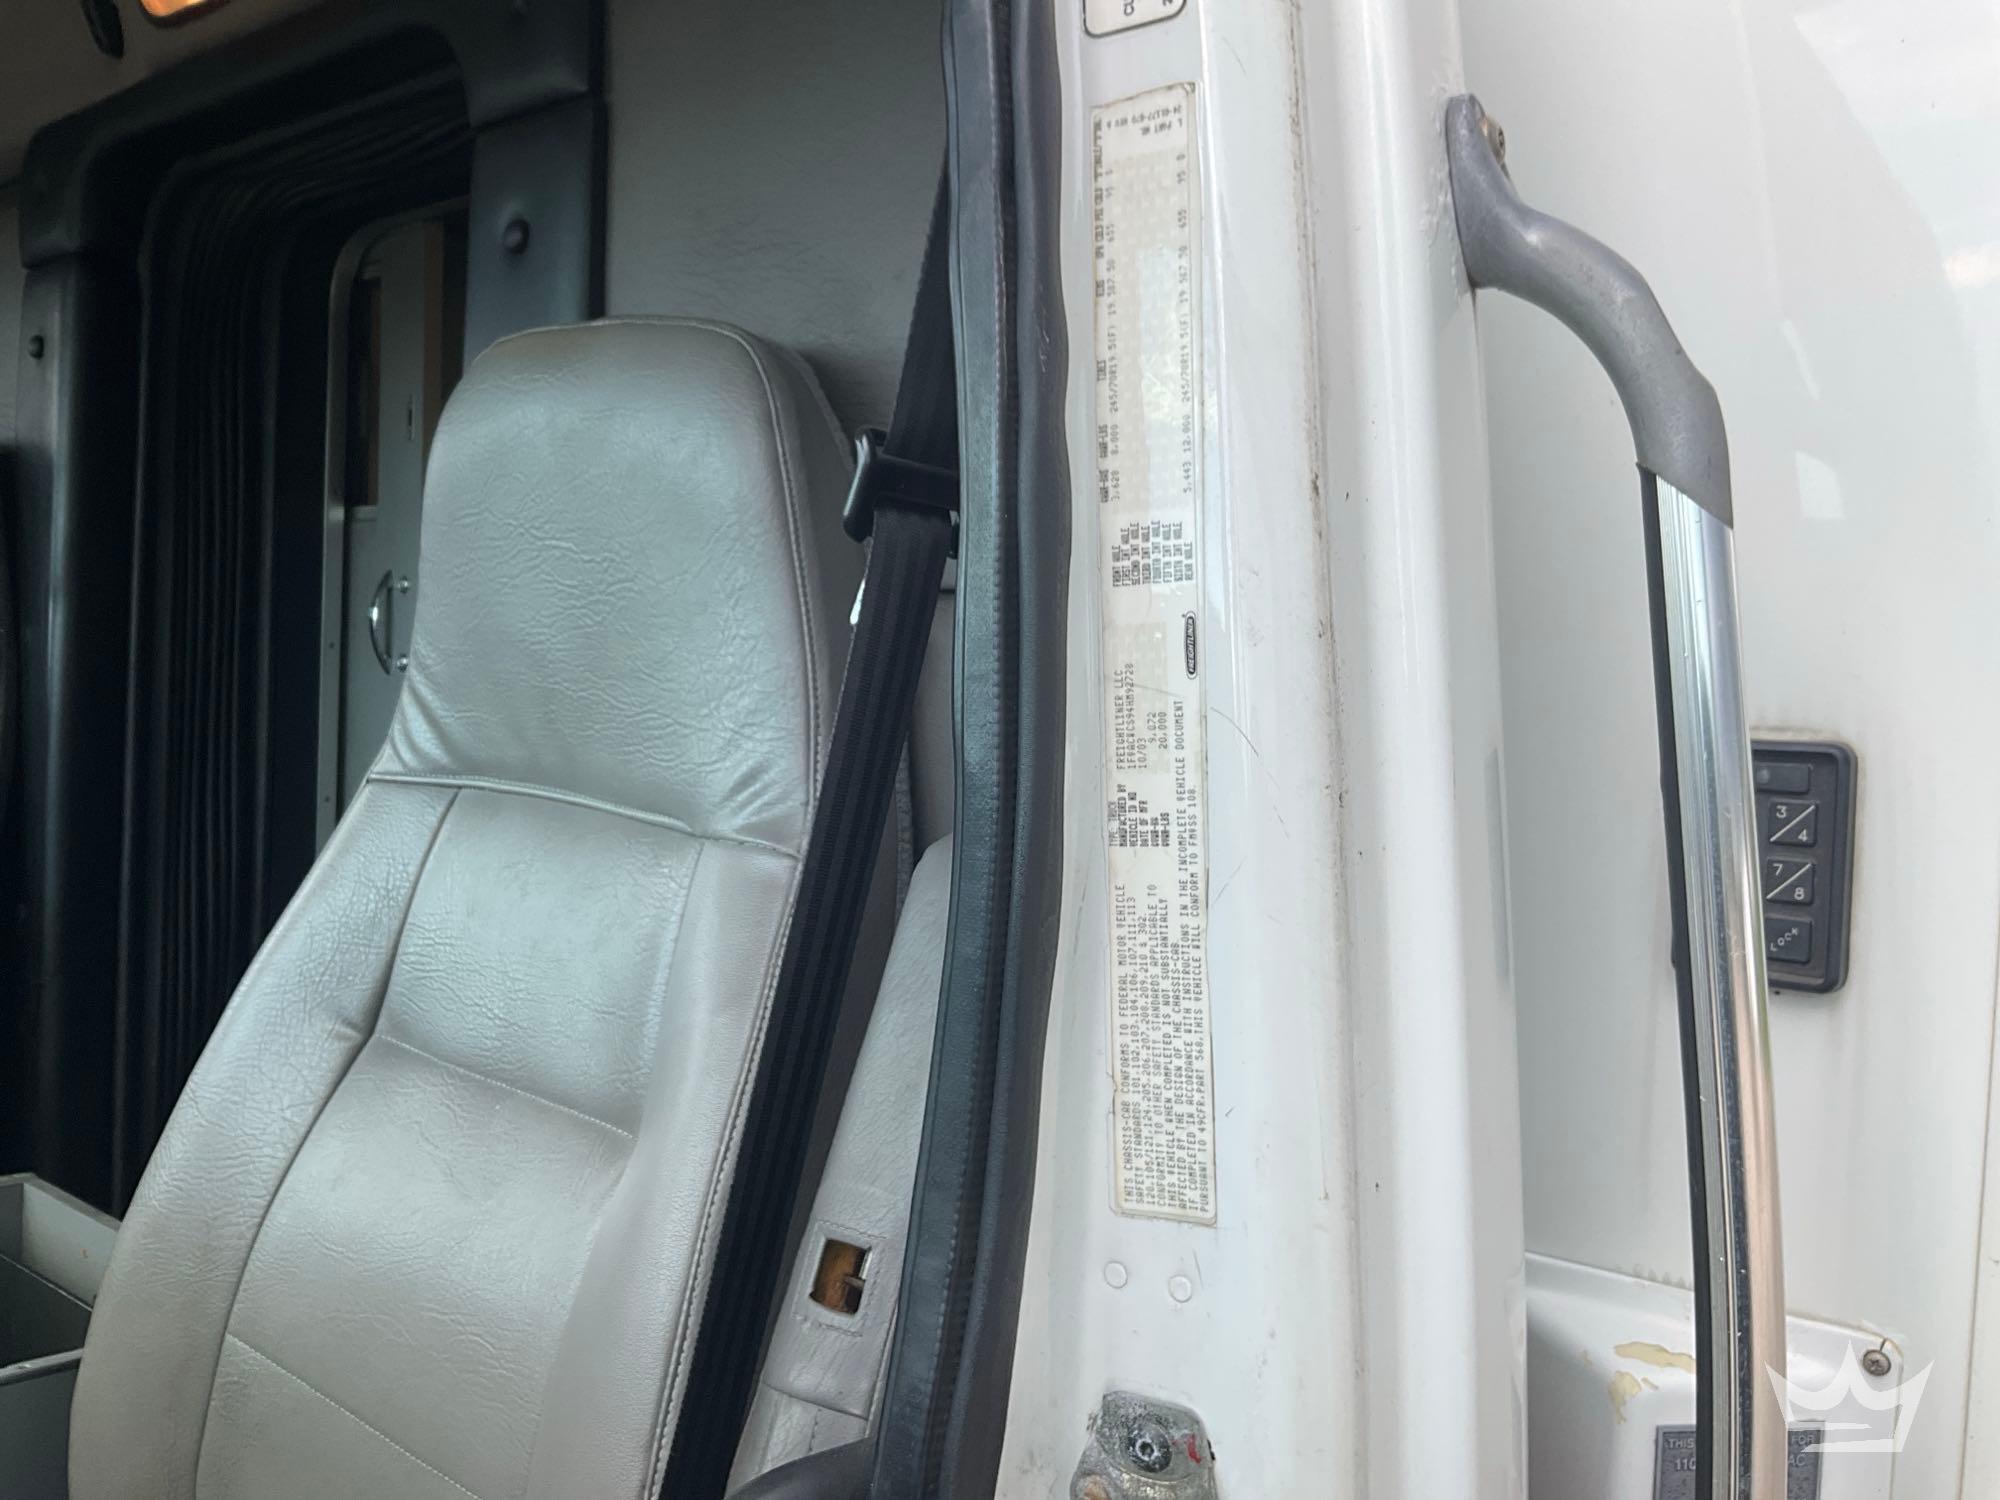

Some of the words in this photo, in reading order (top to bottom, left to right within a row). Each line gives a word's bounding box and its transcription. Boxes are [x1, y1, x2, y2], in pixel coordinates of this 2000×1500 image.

[1186, 618, 1196, 673] FREIGHTLINER
[1114, 670, 1124, 688] LLC
[1114, 694, 1126, 770] FREIGHTLINER
[1174, 700, 1184, 750] DOCUMENT
[1137, 738, 1147, 769] 10/03
[1176, 757, 1186, 802] VEHICLE
[1776, 806, 1787, 818] 3
[1139, 830, 1149, 848] DATE
[1177, 808, 1188, 872] INCOMPLETE
[1187, 814, 1198, 846] FMVSS
[1798, 830, 1808, 841] 4
[1188, 852, 1198, 864] TO
[1772, 864, 1783, 876] 7
[1147, 884, 1157, 896] TO
[1178, 878, 1188, 897] THE
[1189, 872, 1200, 918] CONFORM
[1794, 888, 1804, 900] 8
[1115, 884, 1126, 928] VEHICLE
[1180, 904, 1188, 916] IN
[1116, 935, 1126, 966] MOTOR
[1148, 904, 1158, 966] APPLICABLE
[1158, 898, 1170, 980] SUBSTANTIALLY
[1191, 924, 1200, 949] WILL
[1770, 927, 1799, 952] LOCK
[1180, 924, 1192, 1001] INSTRUCTIONS
[1118, 973, 1128, 1016] FEDERAL
[1192, 956, 1202, 1002] VEHICLE
[1150, 974, 1160, 1032] STANDARDS
[1160, 988, 1170, 1006] NOT
[1120, 1024, 1129, 1036] TO
[1162, 1013, 1171, 1026] IS
[1172, 1020, 1182, 1038] THE
[1182, 1008, 1192, 1033] WITH
[1152, 1039, 1162, 1076] SAFETY
[1162, 1032, 1172, 1090] COMPLETED
[1172, 1046, 1182, 1059] OF
[1120, 1043, 1130, 1094] CONFORMS
[1183, 1040, 1194, 1106] ACCORDANCE
[1152, 1084, 1162, 1116] OTHER
[1174, 1066, 1184, 1104] DESIGN
[1164, 1098, 1174, 1123] WHEN
[1174, 1111, 1184, 1130] THE
[1184, 1112, 1194, 1124] IN
[1121, 1100, 1132, 1170] CHASSIS-CAB
[1132, 1102, 1143, 1158] STANDARDS
[1154, 1122, 1164, 1134] TO
[1165, 1129, 1176, 1174] VEHICLE
[1176, 1138, 1186, 1150] BY
[1198, 1139, 1207, 1152] TO
[1155, 1143, 1166, 1206] CONFORMITY
[1186, 1132, 1197, 1190] COMPLETED
[1124, 1178, 1134, 1202] THIS
[1134, 1167, 1144, 1204] SAFETY
[1167, 1182, 1176, 1207] THIS
[1176, 1156, 1187, 1209] AFFECTED
[1198, 1160, 1208, 1212] PURSUANT
[1188, 1198, 1198, 1210] IF
